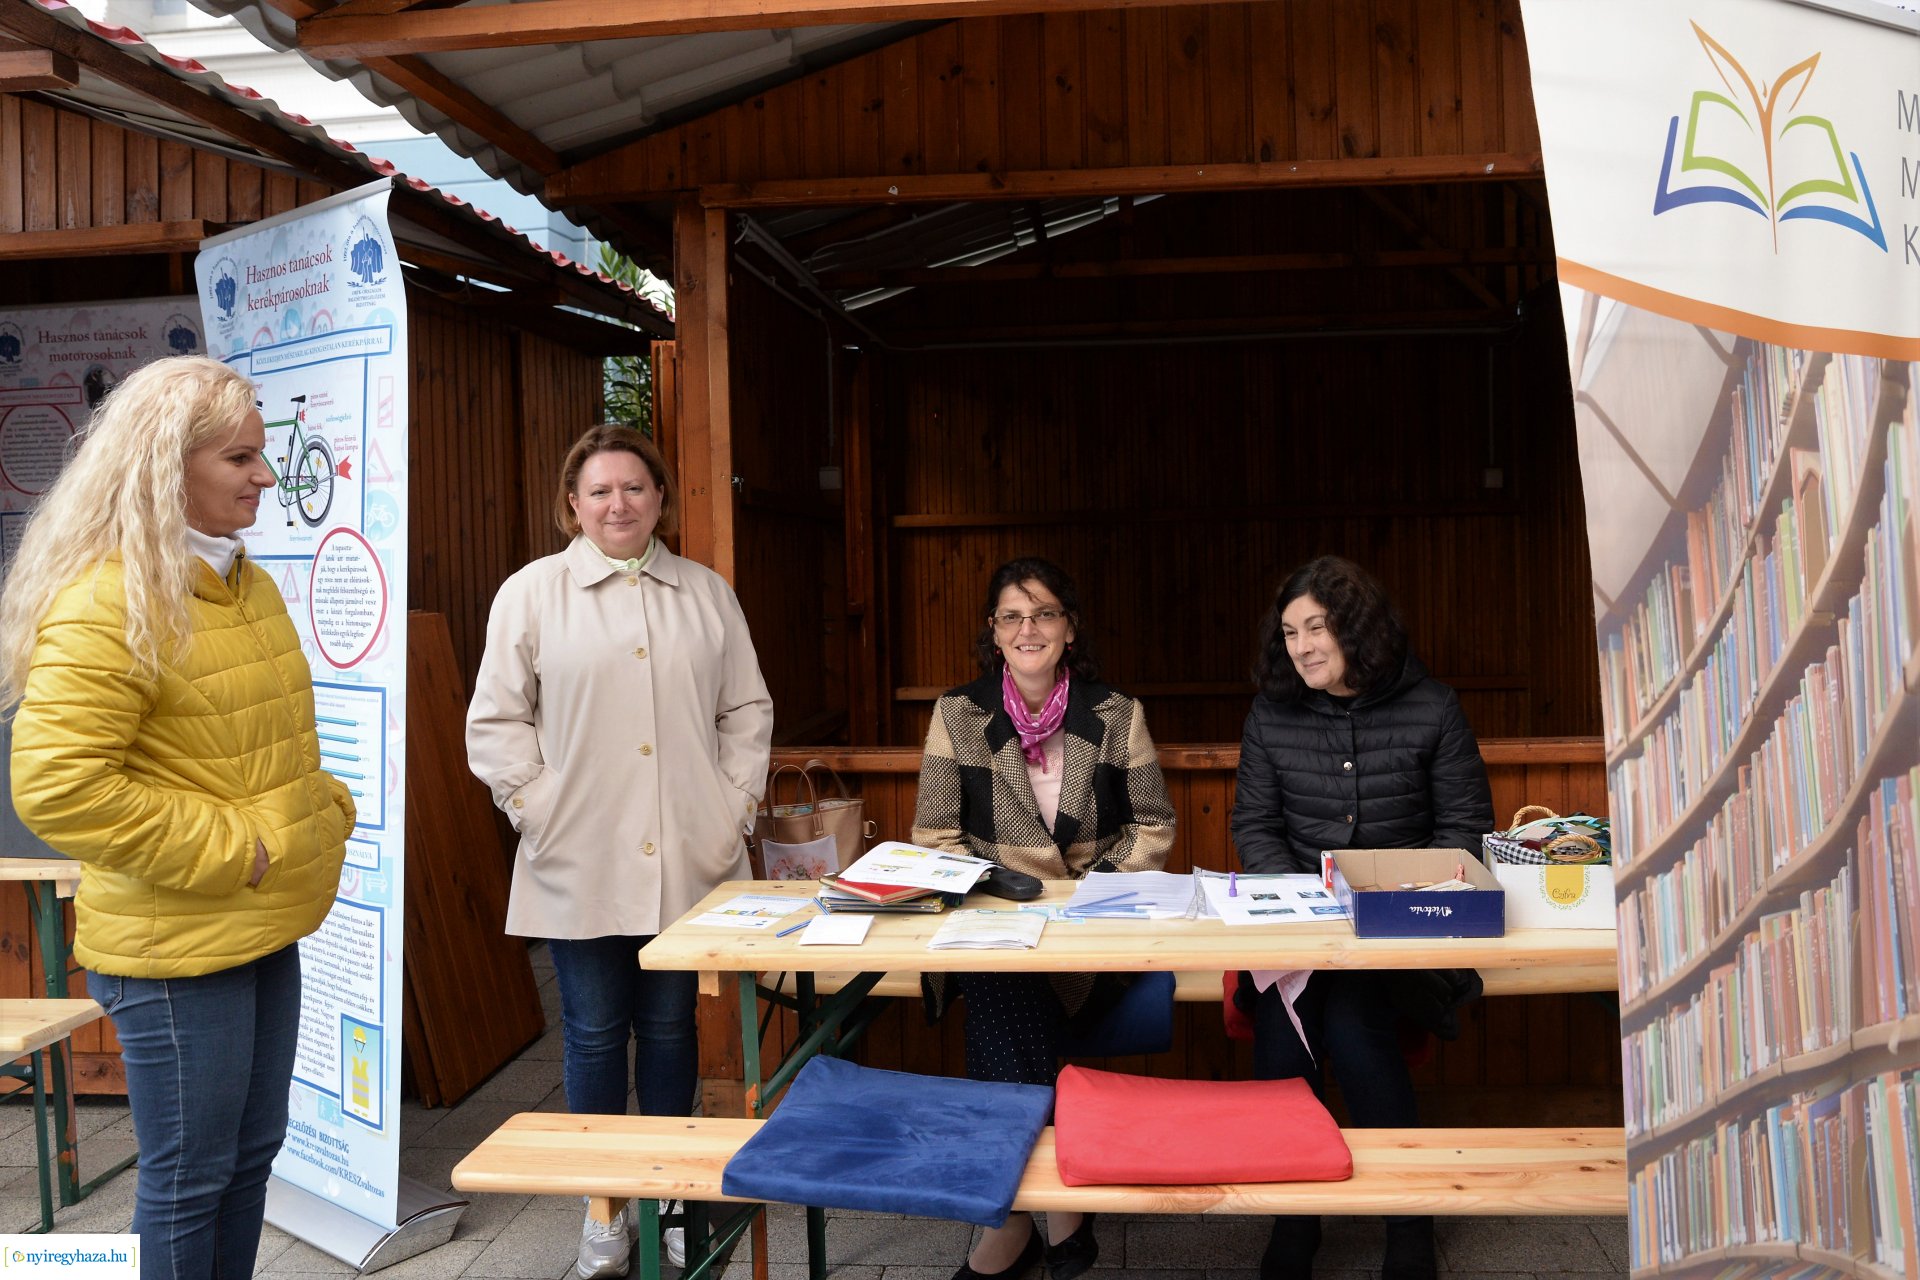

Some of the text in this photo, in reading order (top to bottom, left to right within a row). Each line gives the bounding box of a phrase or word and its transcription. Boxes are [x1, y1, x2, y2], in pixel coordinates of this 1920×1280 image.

[246, 264, 287, 286] Hasznos
[289, 244, 333, 272] tanácsok
[247, 273, 330, 313] kerékpárosoknak
[38, 326, 148, 344] Hasznos tanácsok
[49, 346, 136, 362] motorosoknak
[1409, 906, 1450, 917] Victoria
[319, 1131, 350, 1155] BIZOTTSÁG
